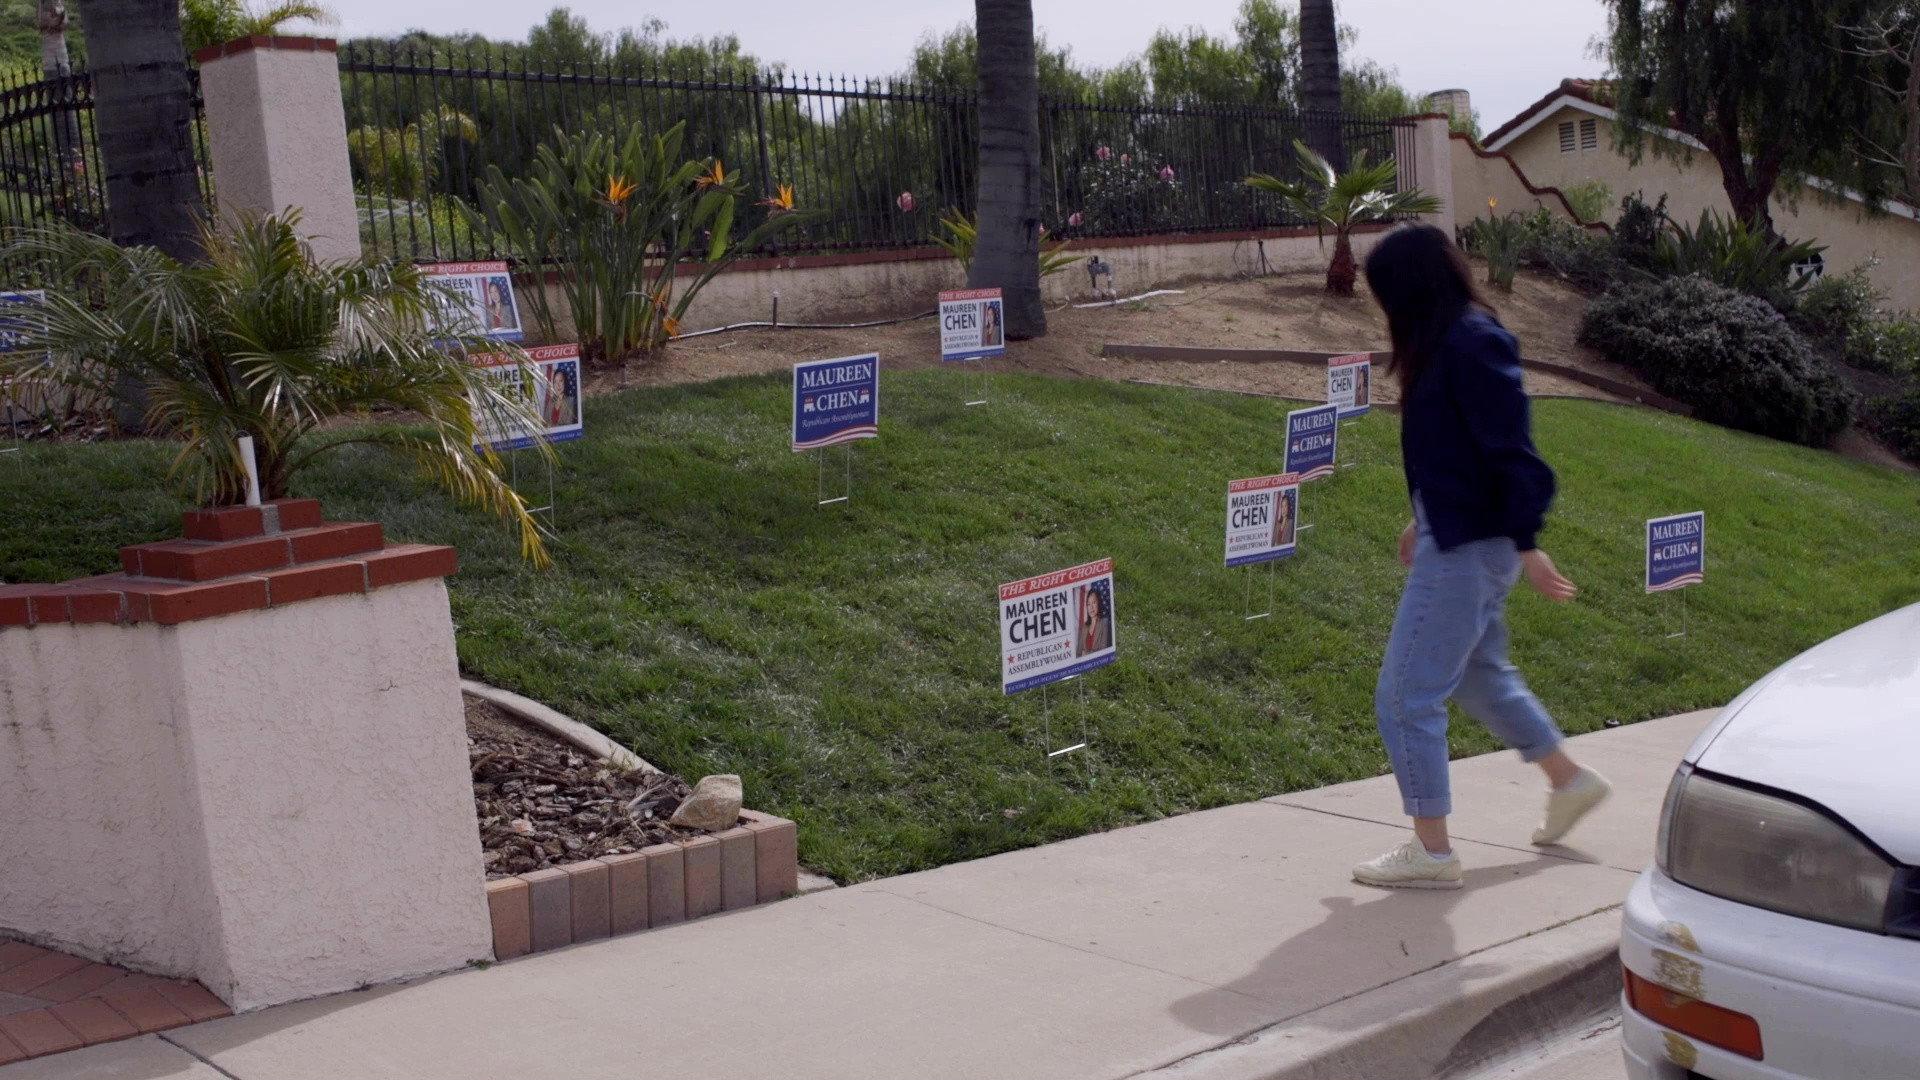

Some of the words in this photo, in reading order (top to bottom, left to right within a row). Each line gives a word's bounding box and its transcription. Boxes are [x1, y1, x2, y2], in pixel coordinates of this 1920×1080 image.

[439, 264, 468, 274] RIGHT
[471, 263, 504, 272] CHOICE
[943, 303, 977, 314] MAUREEN
[945, 314, 976, 331] CHEN
[535, 345, 577, 359] CHOICE
[802, 363, 872, 388] MAUREEN
[1332, 377, 1352, 393] CHEN
[816, 390, 859, 411] CHEN
[1292, 412, 1334, 432] MAUREEN
[1300, 434, 1325, 452] CHEN
[1231, 481, 1246, 490] THE
[1247, 479, 1270, 489] RIGHT
[1271, 475, 1297, 485] CHOICE
[1231, 493, 1270, 508] MAUREEN
[1232, 506, 1268, 528] CHEN
[1653, 520, 1700, 541] MAUREEN
[1662, 542, 1690, 560] CHEN
[1001, 583, 1026, 598] THE
[1029, 573, 1067, 591] RIGHT
[1068, 560, 1110, 580] CHOICE
[1006, 590, 1068, 620] MAUREEN
[1009, 607, 1066, 644] CHEN
[1016, 641, 1062, 662] REPUBLICAN
[1008, 651, 1071, 675] ASSEMBLYWOMAN
